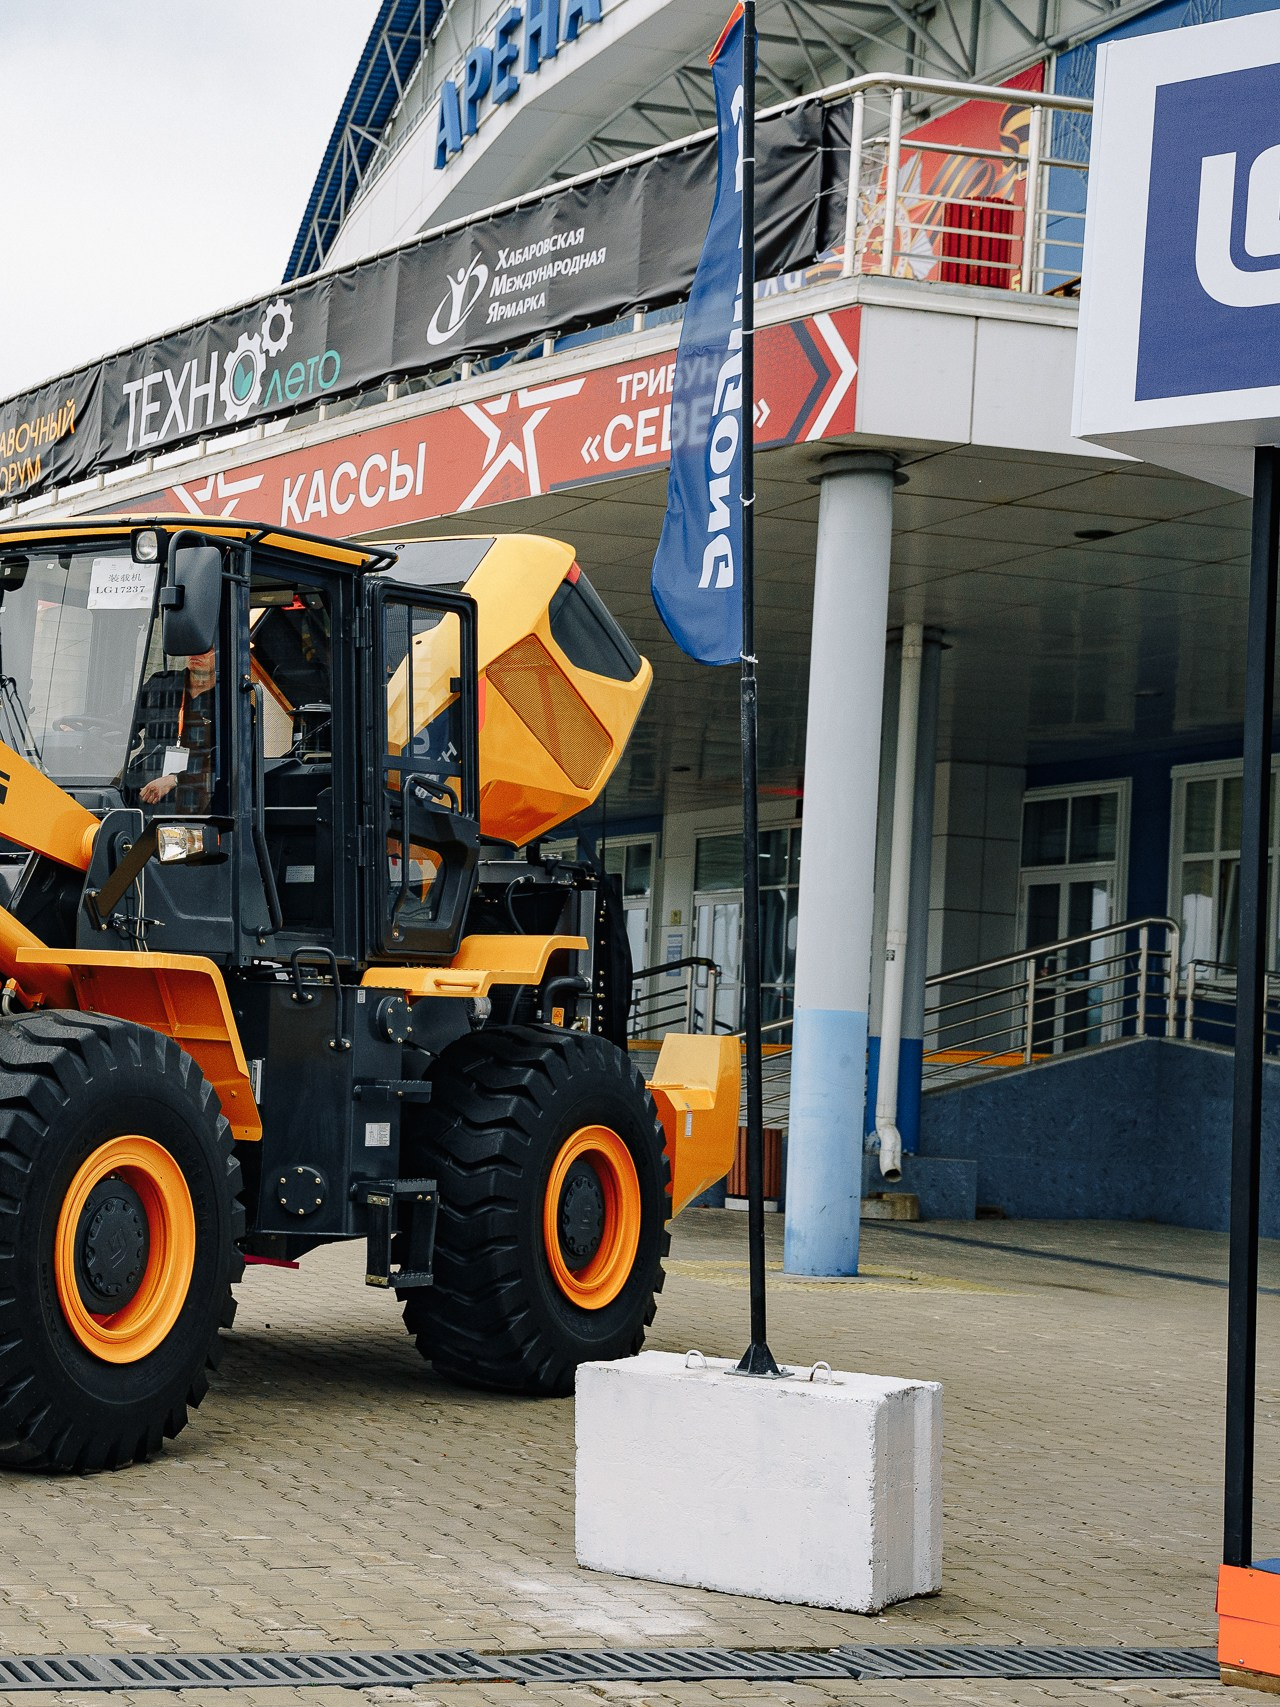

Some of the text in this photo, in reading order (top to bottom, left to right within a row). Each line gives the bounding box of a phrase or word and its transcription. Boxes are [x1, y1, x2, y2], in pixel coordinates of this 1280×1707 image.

[489, 246, 607, 298] МЕЖДУНАРОДНАЯ
[494, 227, 585, 272] ХАБАРОВСКАЯ
[485, 291, 546, 325] ЯРМАРКА
[280, 441, 427, 528] КАССЫ
[96, 585, 146, 594] LG17237
